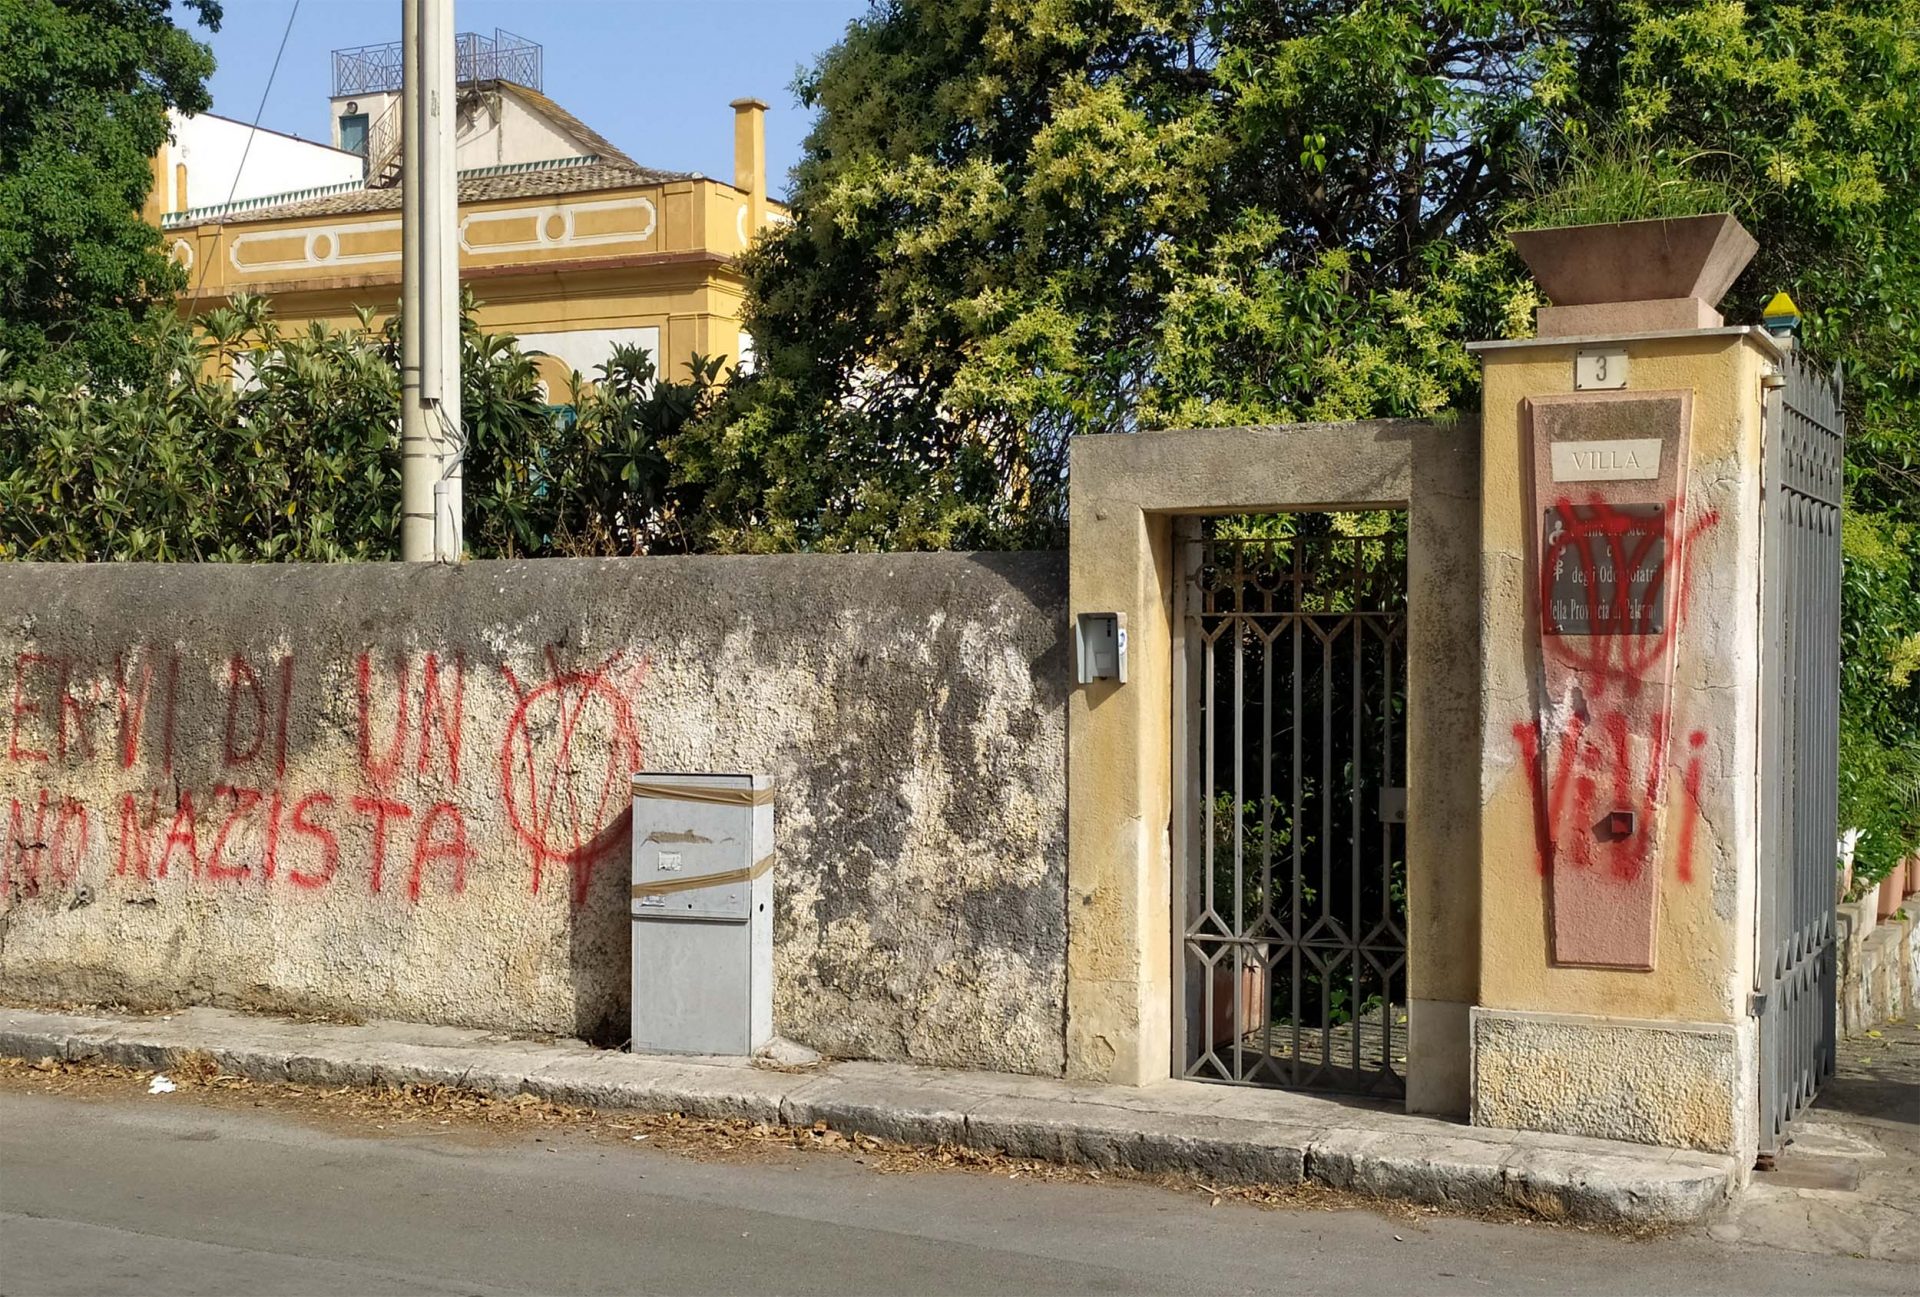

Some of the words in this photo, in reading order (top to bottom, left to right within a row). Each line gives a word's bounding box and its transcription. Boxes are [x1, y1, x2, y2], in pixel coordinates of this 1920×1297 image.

[1596, 355, 1608, 381] 3
[1572, 450, 1641, 471] VILLA
[1571, 564, 1596, 587] degi
[1599, 564, 1659, 583] Odoiatr
[1570, 597, 1610, 620] Provcia
[224, 651, 294, 779] DI
[355, 651, 465, 790] UN
[116, 784, 479, 903] NAZISTA
